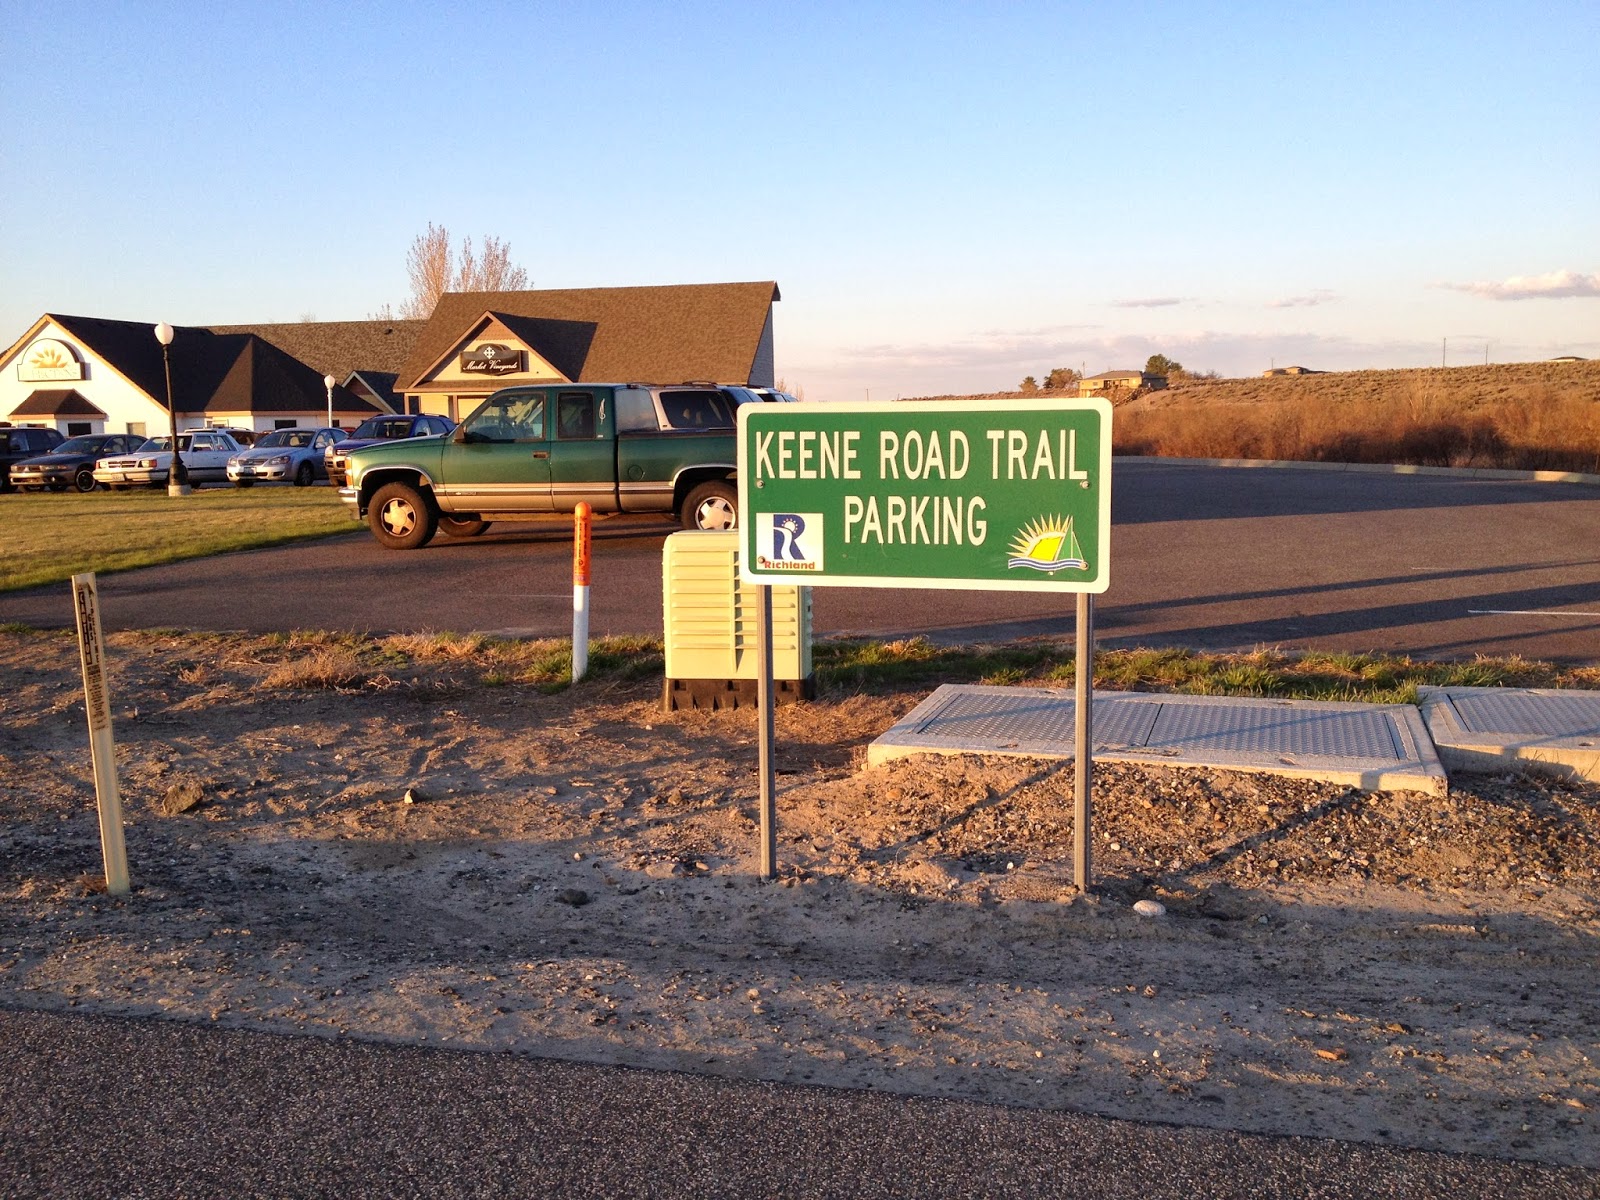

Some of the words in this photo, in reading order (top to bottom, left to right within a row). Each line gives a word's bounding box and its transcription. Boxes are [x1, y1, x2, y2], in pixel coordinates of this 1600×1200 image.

[755, 430, 861, 479] KEENE
[879, 429, 970, 480] ROAD
[986, 429, 1088, 480] TRAIL
[844, 495, 987, 546] PARKING
[764, 560, 816, 570] Richland
